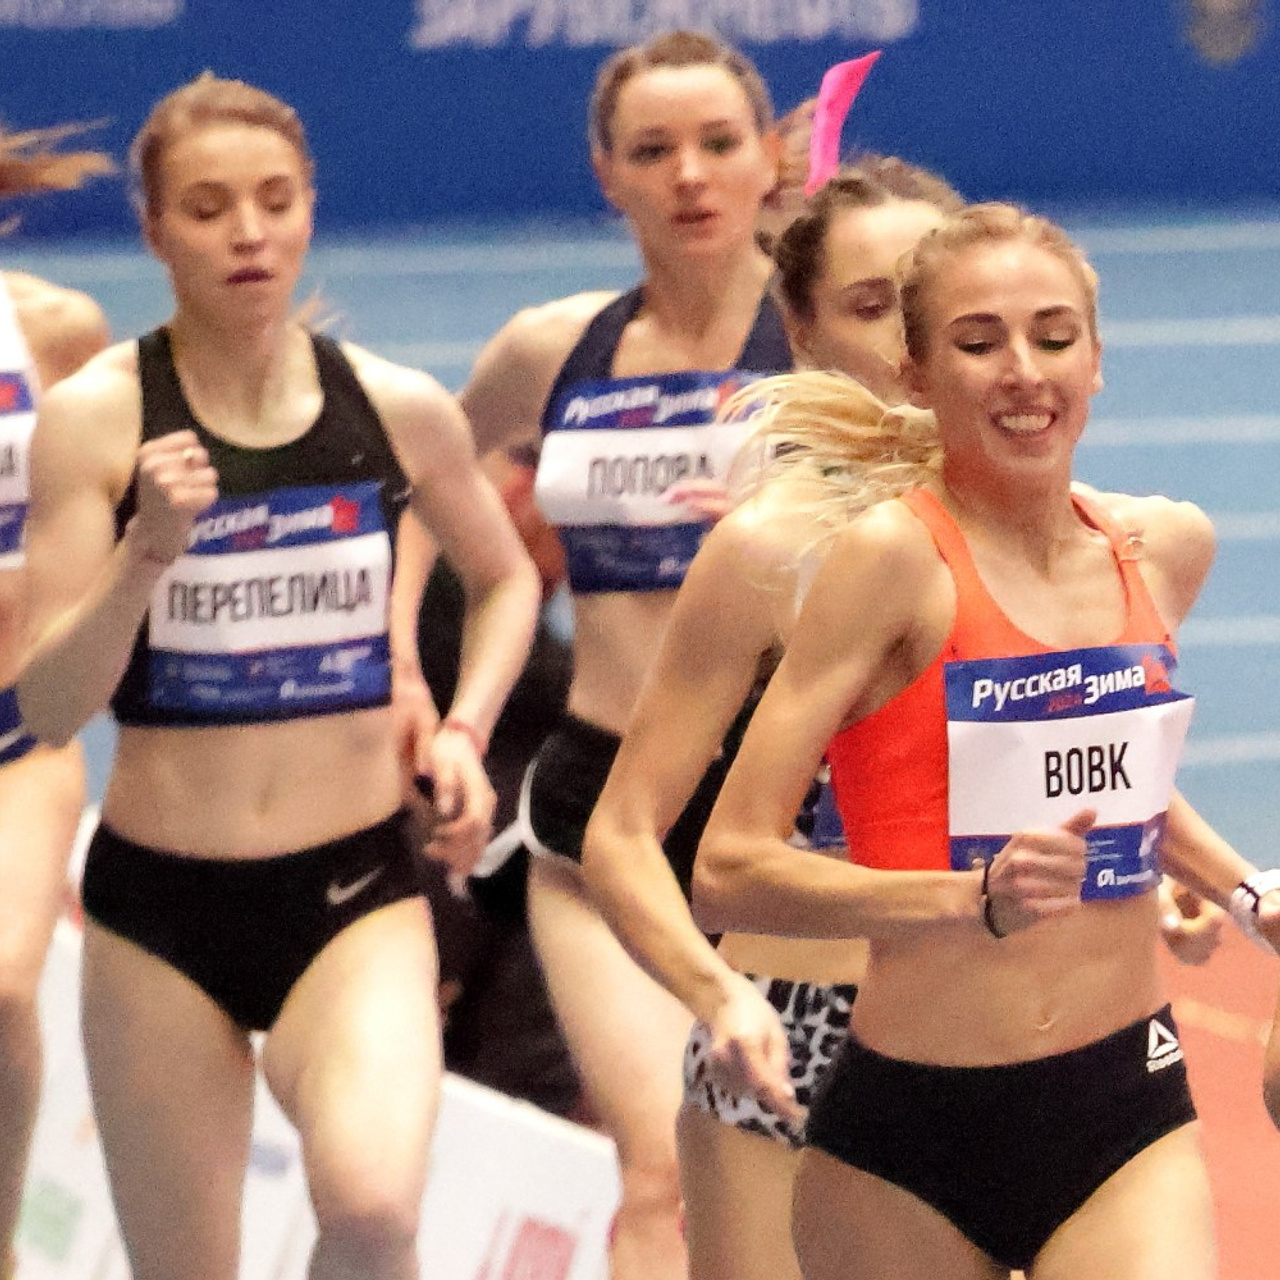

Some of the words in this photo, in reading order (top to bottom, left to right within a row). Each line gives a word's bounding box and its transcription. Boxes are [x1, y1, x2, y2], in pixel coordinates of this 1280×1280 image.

[168, 569, 373, 625] ПЕРЕПЕЛИЦА
[972, 664, 1082, 711] Русская
[1083, 665, 1146, 704] Зима
[1045, 742, 1132, 798] ВОВК
